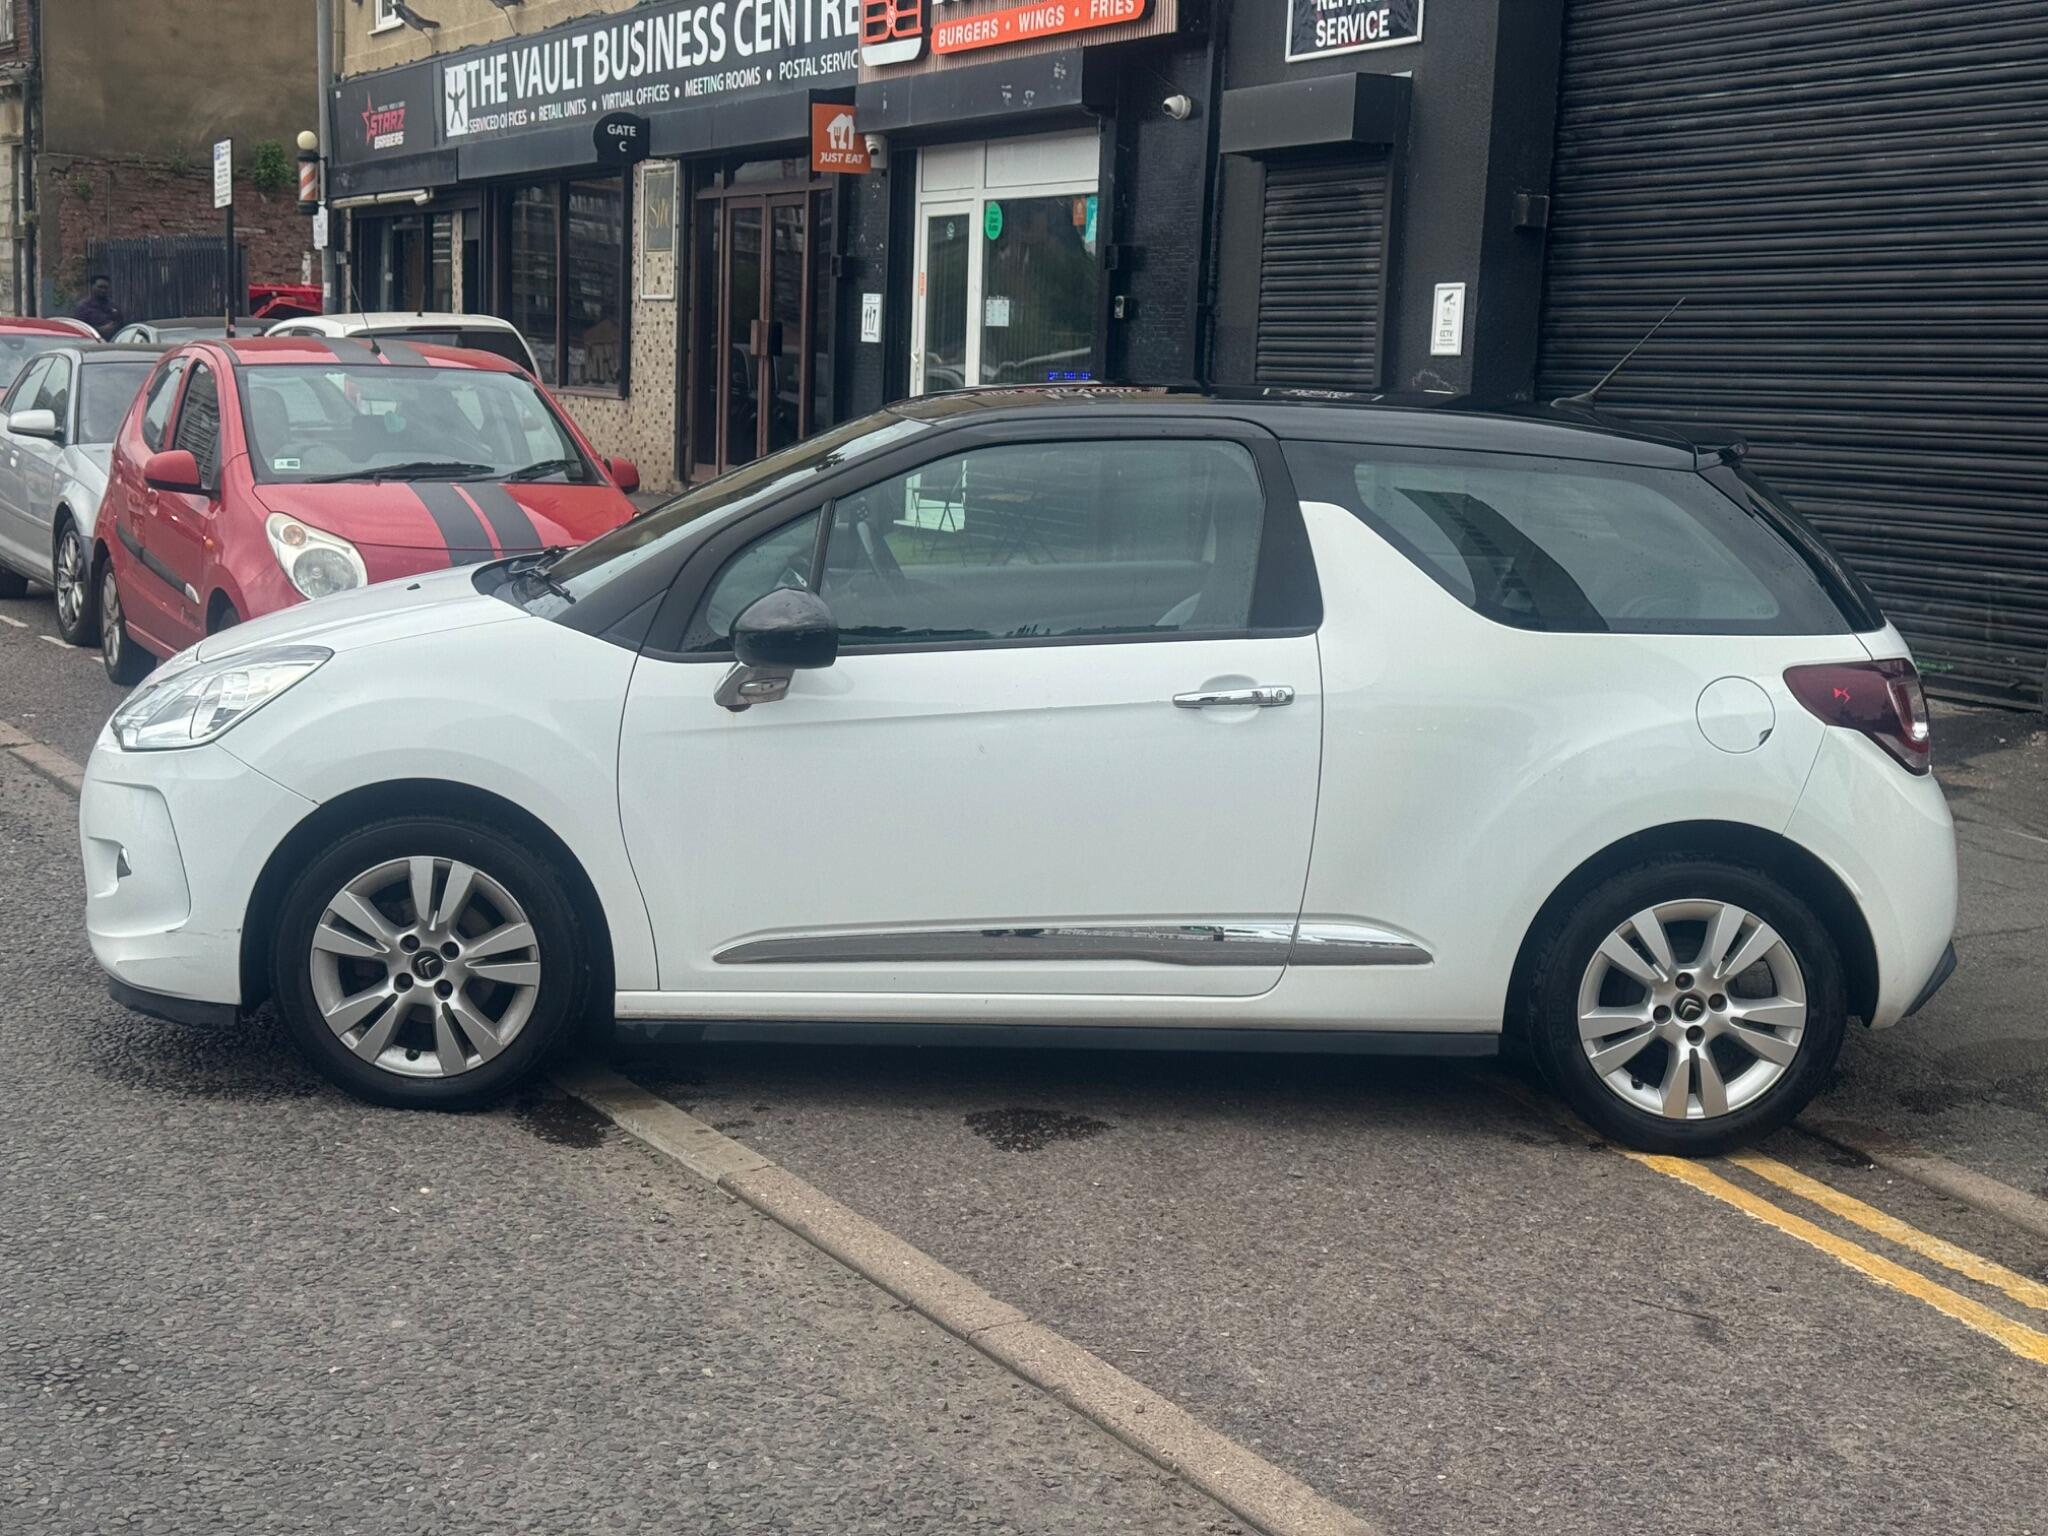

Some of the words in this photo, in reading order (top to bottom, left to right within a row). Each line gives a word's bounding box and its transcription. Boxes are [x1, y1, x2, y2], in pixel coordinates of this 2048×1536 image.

[938, 18, 999, 48] BURGERS
[1018, 5, 1065, 33] WINGS
[1090, 0, 1134, 19] FRIES
[1315, 8, 1390, 47] SERVICE
[467, 53, 507, 108] THE
[512, 35, 588, 99] VAULT
[593, 2, 727, 85] BUSINESS
[468, 115, 499, 134] SERVICED
[538, 103, 563, 121] RETAIL
[564, 99, 587, 116] UNITS
[602, 90, 635, 110] VIRTUAL
[636, 84, 670, 104] OFFICES
[686, 73, 724, 97] MEETING
[726, 66, 761, 89] ROOMS
[780, 57, 818, 80] POSTAL
[370, 108, 405, 136] STARZ
[608, 124, 637, 137] GATE
[618, 141, 627, 152] C
[820, 152, 844, 164] JUST
[845, 153, 864, 164] EAT
